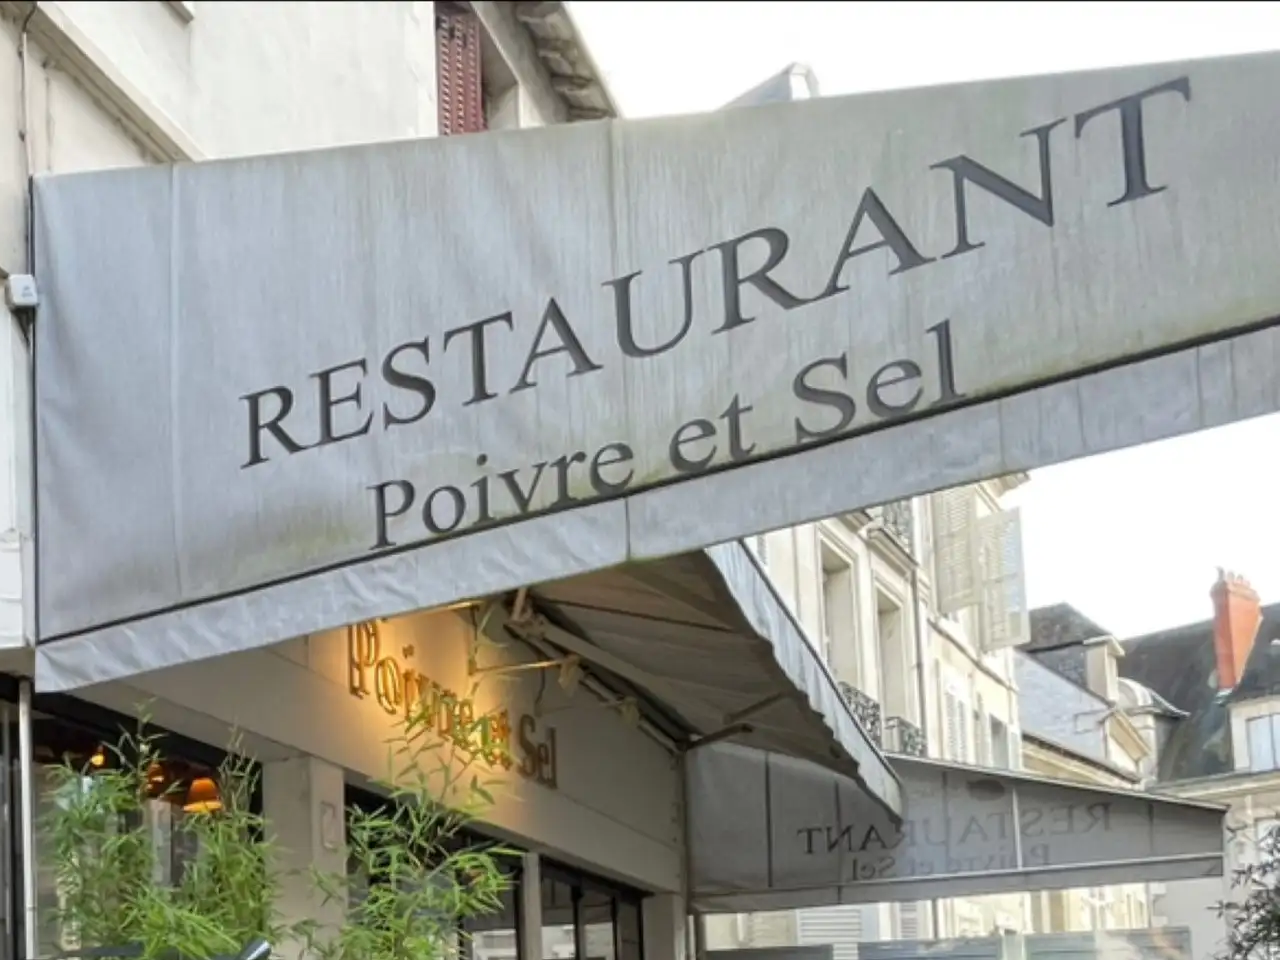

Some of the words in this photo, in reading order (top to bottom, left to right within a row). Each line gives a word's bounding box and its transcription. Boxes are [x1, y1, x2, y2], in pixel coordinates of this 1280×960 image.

[238, 77, 1191, 470] RESTAURANT
[367, 440, 635, 551] Poivre
[668, 393, 756, 473] et
[792, 319, 967, 445] Sel
